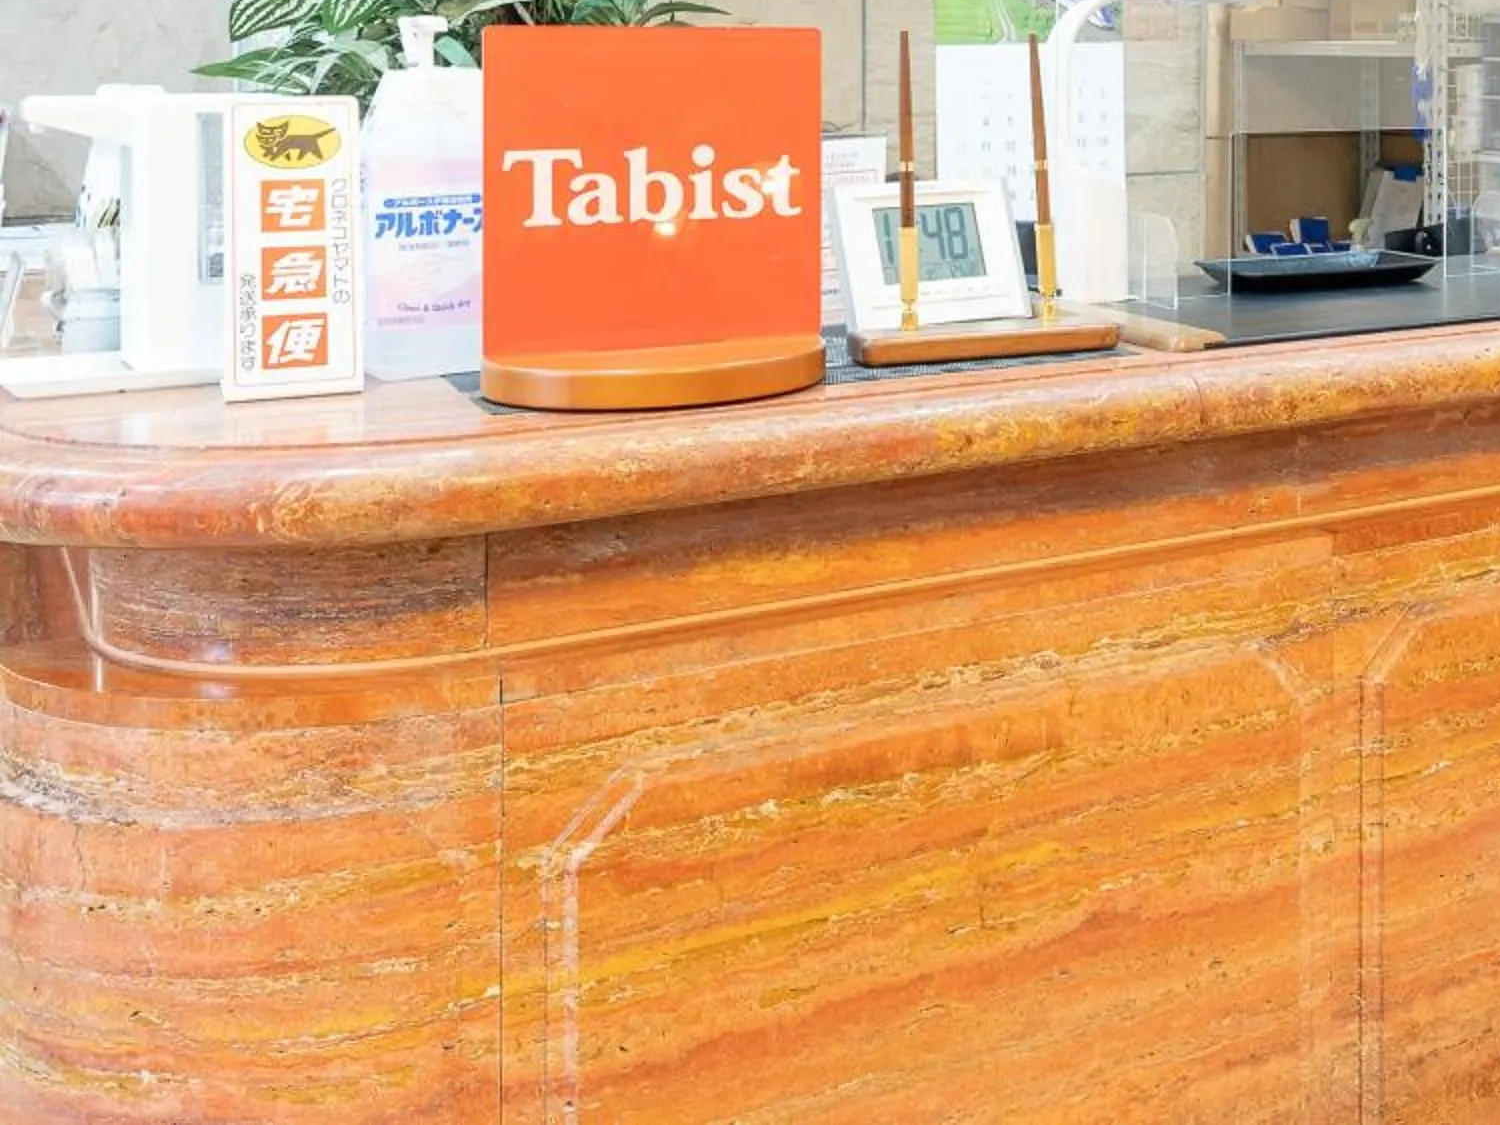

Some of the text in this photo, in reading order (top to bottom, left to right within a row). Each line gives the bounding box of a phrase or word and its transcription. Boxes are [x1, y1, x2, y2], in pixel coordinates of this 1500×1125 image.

[501, 144, 802, 228] Tabist
[263, 185, 326, 365] 宅急便
